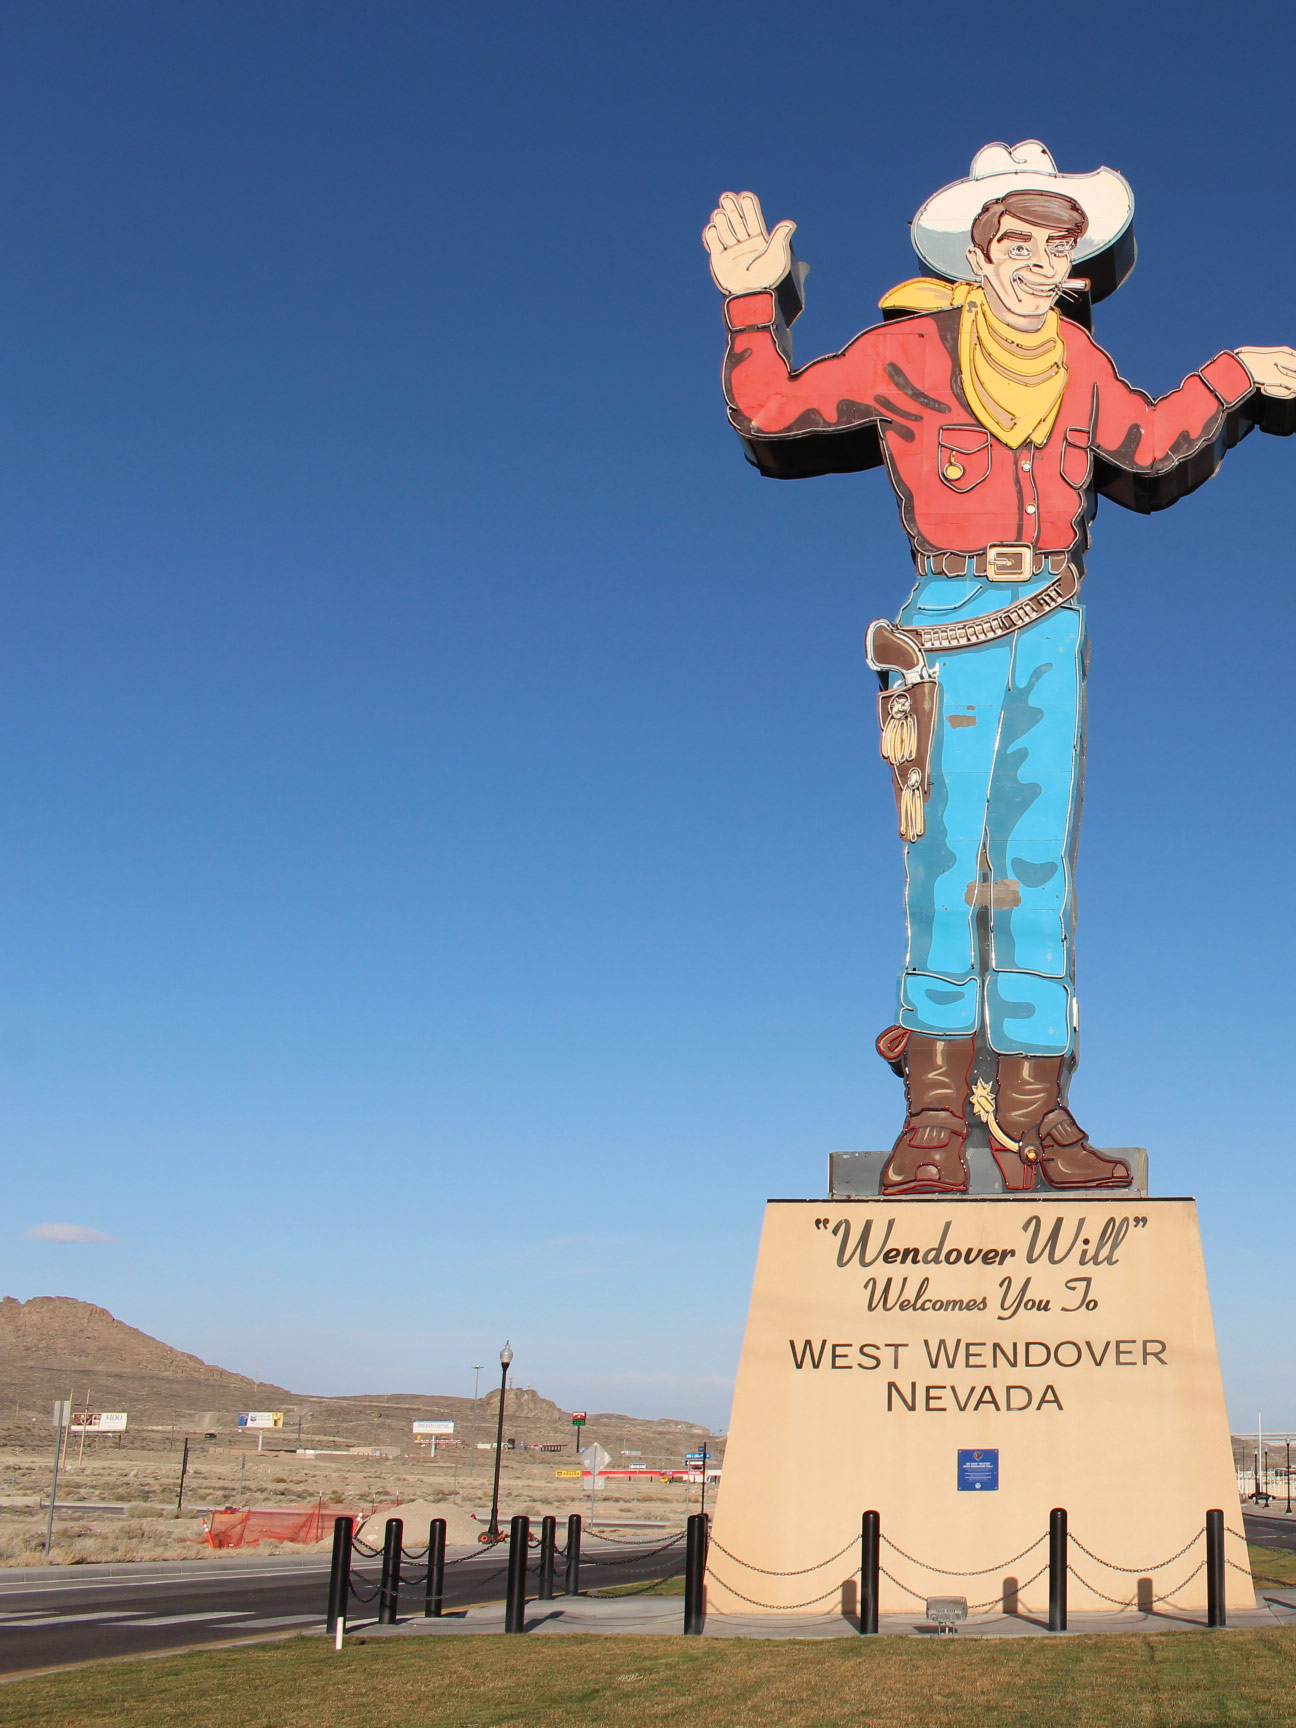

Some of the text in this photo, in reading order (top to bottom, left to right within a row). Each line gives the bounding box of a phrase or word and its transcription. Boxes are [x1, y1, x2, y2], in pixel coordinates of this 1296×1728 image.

[863, 1275, 1099, 1321] Welcomes You To
[788, 1337, 1169, 1371] WEST WENDOVER
[886, 1380, 1065, 1412] NEVADA
